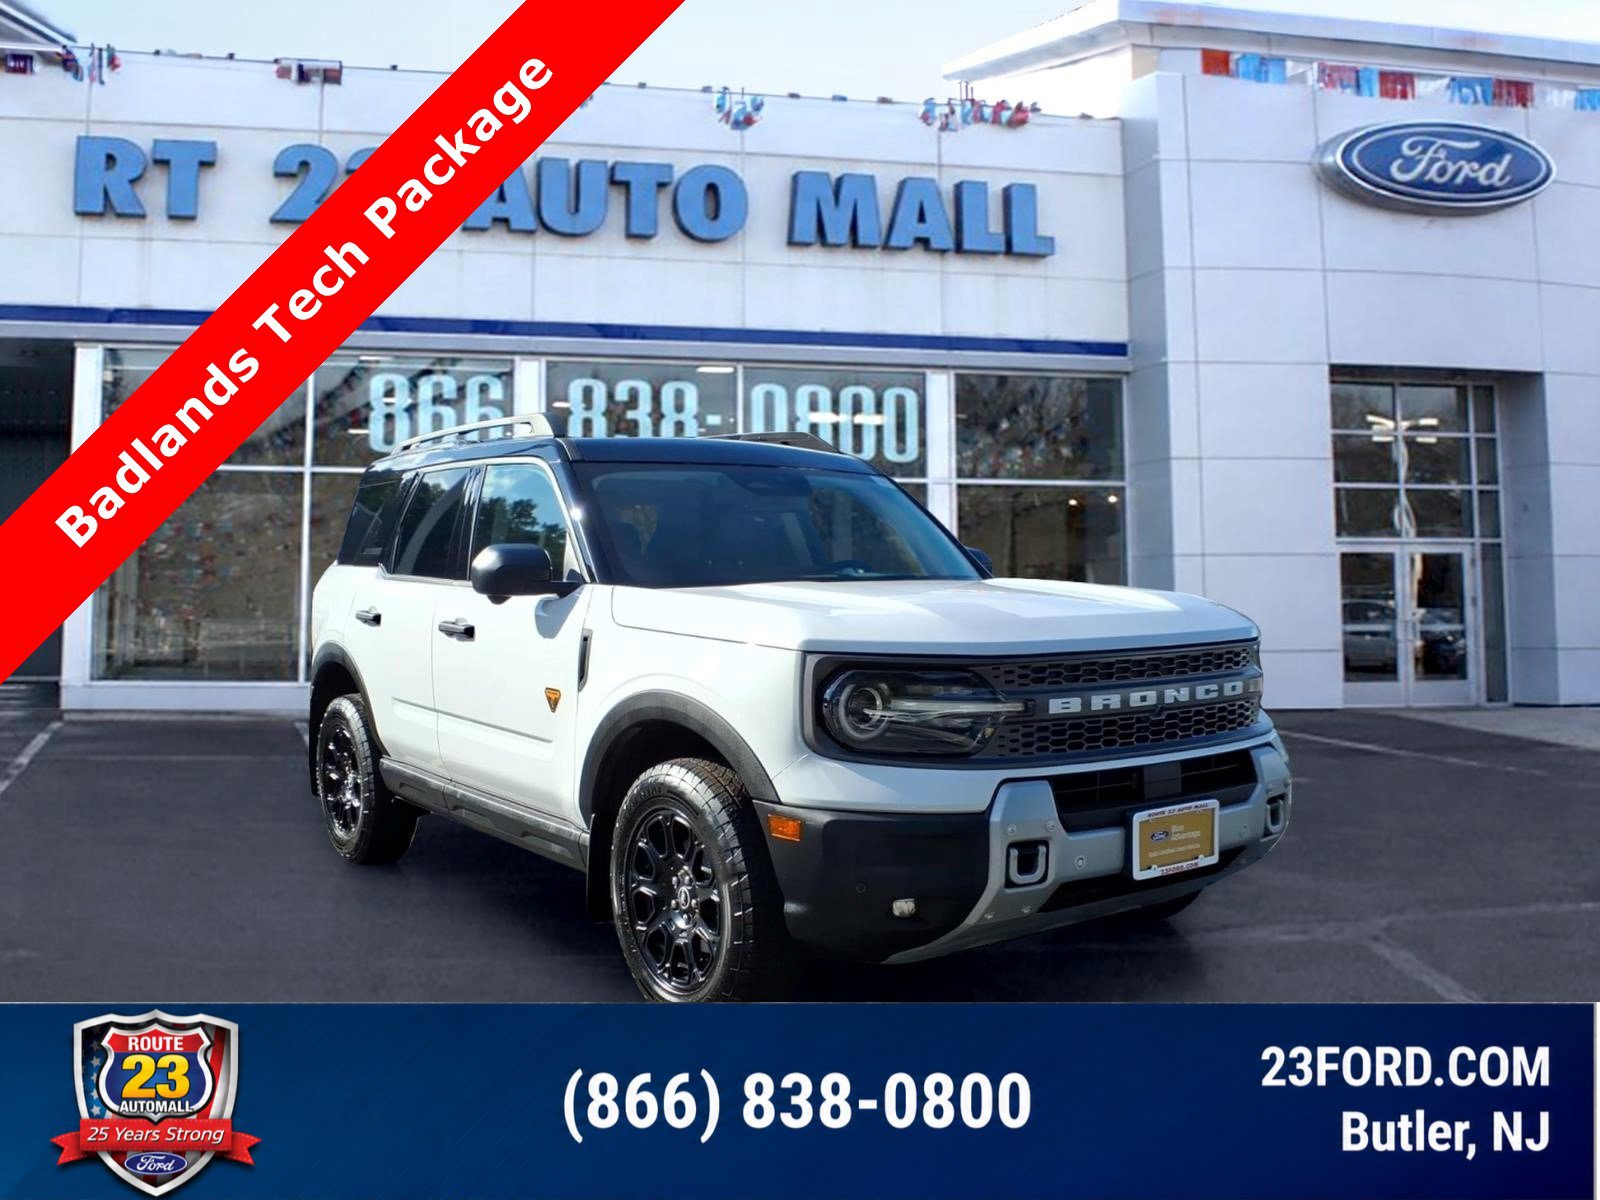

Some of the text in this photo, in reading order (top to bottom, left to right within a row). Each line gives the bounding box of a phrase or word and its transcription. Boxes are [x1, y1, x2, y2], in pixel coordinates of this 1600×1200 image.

[1390, 135, 1513, 187] Ford
[74, 135, 1056, 257] RT 2 AUTO MALL
[369, 373, 505, 453] 866
[1048, 681, 1244, 714] BRONCO
